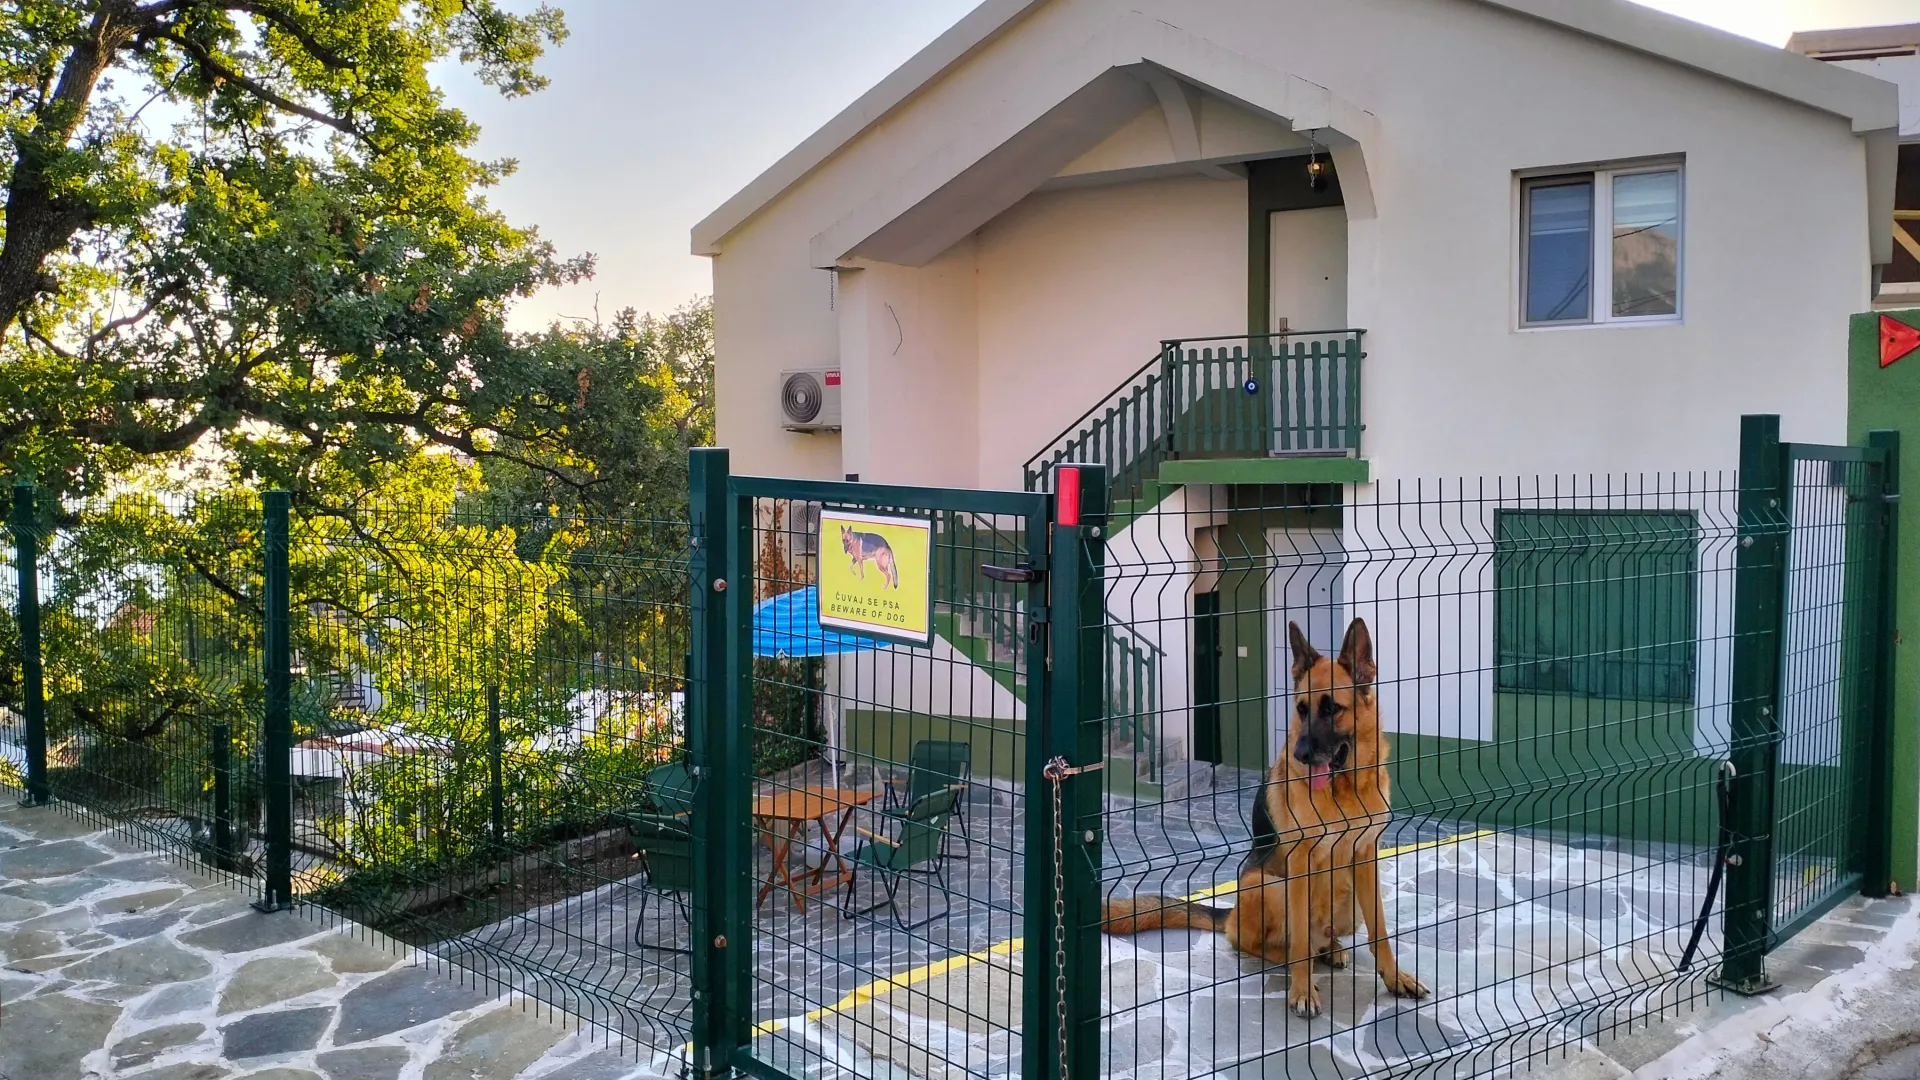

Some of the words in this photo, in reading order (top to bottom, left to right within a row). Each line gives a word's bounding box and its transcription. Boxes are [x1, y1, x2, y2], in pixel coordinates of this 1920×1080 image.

[835, 591, 863, 604] ČUVAJ
[868, 598, 878, 606] SE
[883, 600, 900, 610] PSA
[830, 604, 867, 616] BEWARE
[871, 610, 882, 619] OF
[887, 612, 905, 623] DOG
